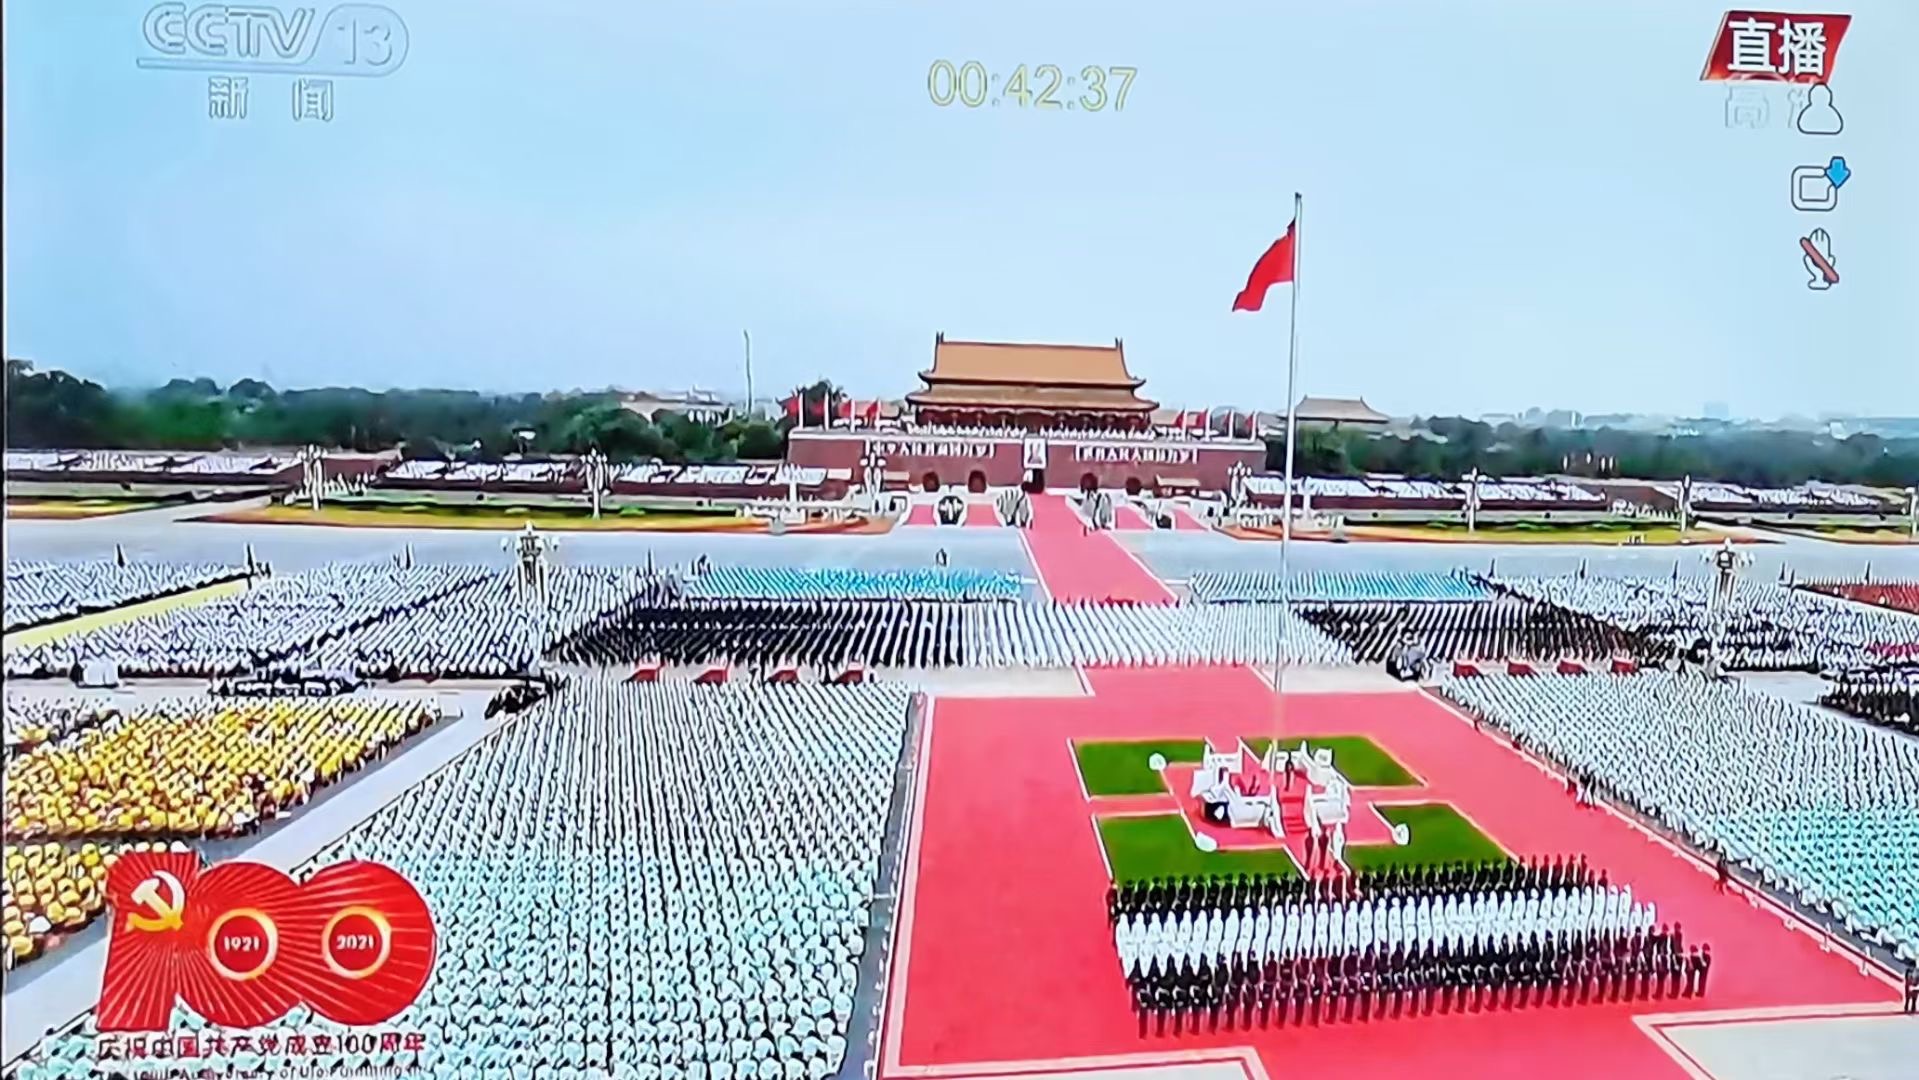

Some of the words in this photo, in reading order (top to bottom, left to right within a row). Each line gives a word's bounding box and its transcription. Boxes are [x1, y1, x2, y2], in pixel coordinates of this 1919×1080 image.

[143, 2, 315, 58] CCTV
[338, 18, 394, 66] 13
[1727, 17, 1827, 76] 直播
[928, 59, 1138, 112] 00:42:37
[223, 936, 260, 951] 1921
[336, 934, 374, 950] 2021
